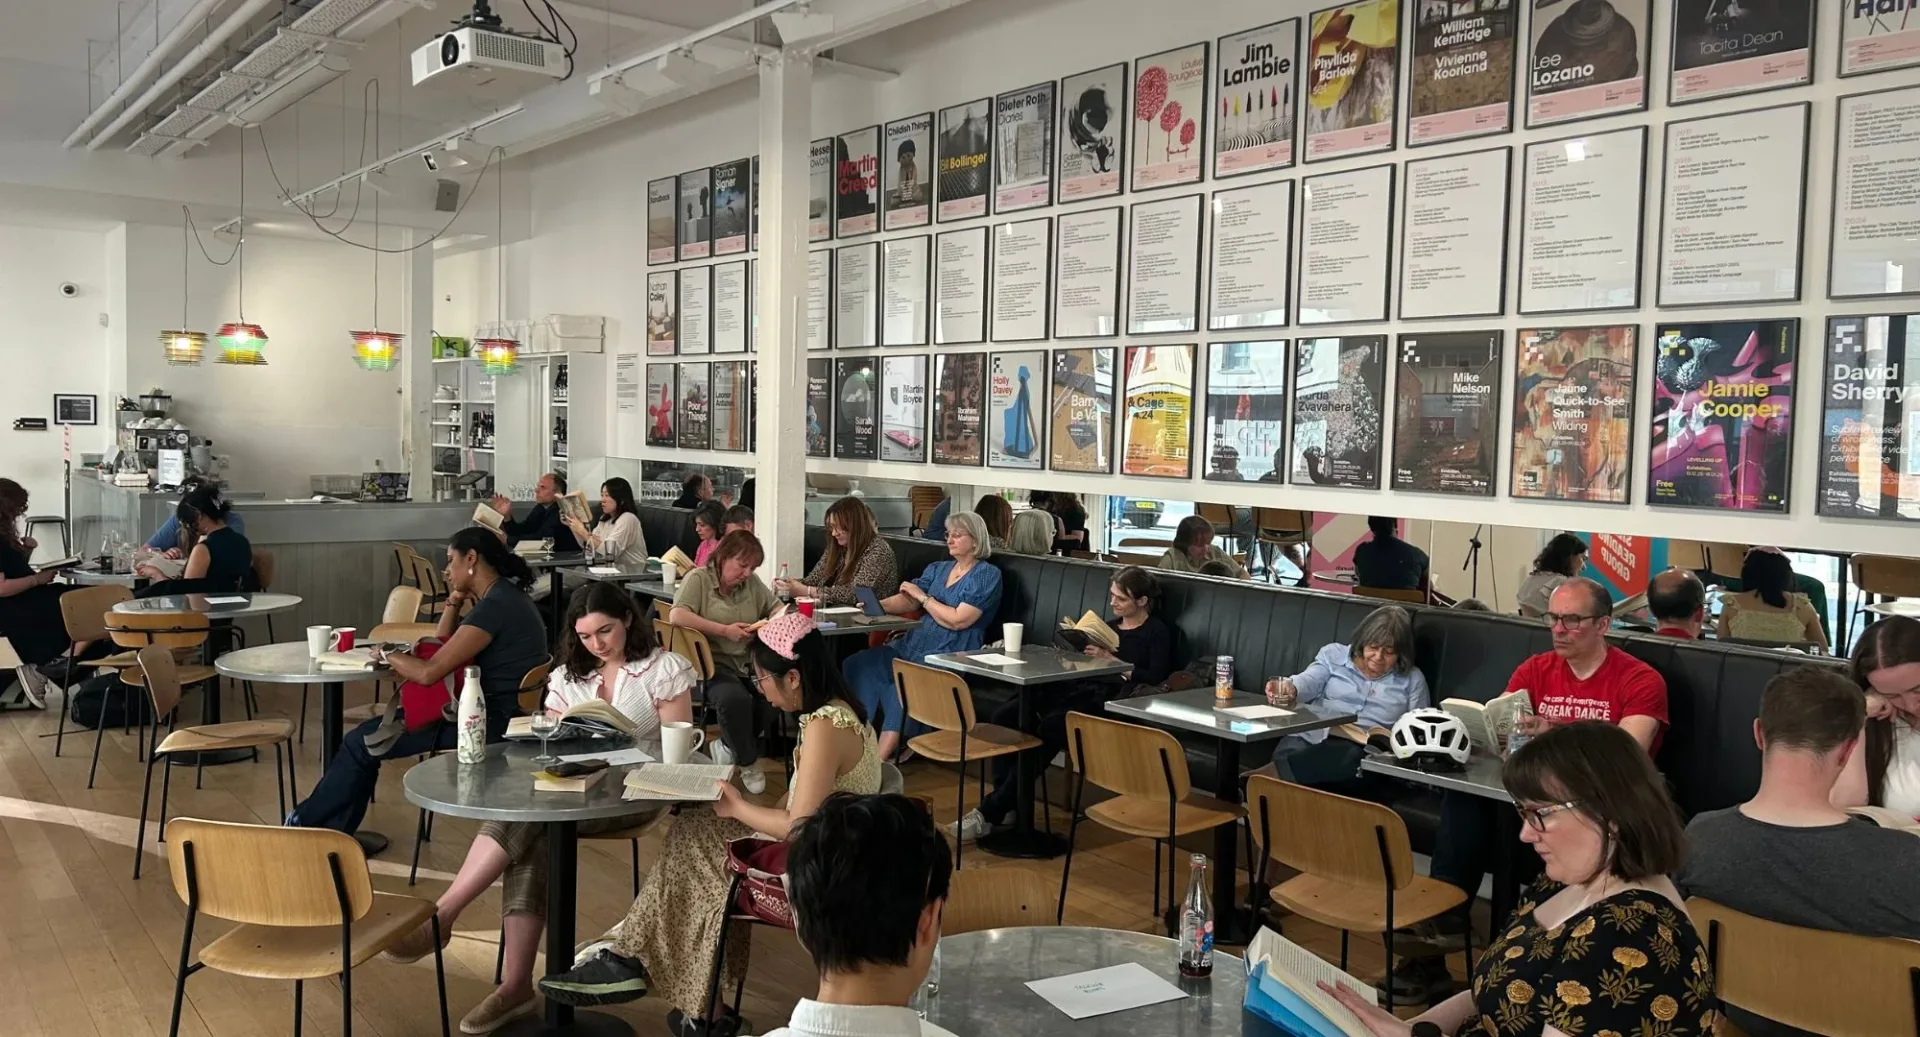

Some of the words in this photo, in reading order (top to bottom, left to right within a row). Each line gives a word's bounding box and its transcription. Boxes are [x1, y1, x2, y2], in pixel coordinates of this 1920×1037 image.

[1441, 17, 1484, 35] William
[1433, 26, 1491, 48] Kentridge
[1700, 38, 1739, 55] Tacita
[1743, 29, 1784, 47] Dean
[1240, 42, 1273, 65] Jim
[1436, 49, 1487, 69] Vivienne
[1313, 51, 1356, 71] Phyllida
[1534, 54, 1561, 70] Lee
[1223, 57, 1291, 87] Lambie
[1318, 65, 1357, 82] Barlow
[1433, 59, 1488, 81] Koorland
[1533, 64, 1595, 87] Lozano
[999, 99, 1024, 113] Dieter
[1025, 91, 1046, 106] Roth
[887, 125, 911, 137] Childish
[839, 154, 878, 177] Martin
[950, 152, 988, 171] Bollinger
[715, 177, 737, 191] Signer
[839, 173, 877, 195] Creed
[649, 292, 665, 303] Coley
[1453, 371, 1480, 383] Mike
[1834, 363, 1899, 381] David
[993, 376, 1010, 386] Holly
[902, 384, 924, 394] Martin
[992, 386, 1013, 395] Davey
[1452, 383, 1491, 394] Nelson
[1554, 383, 1587, 394] Jaune
[1700, 380, 1769, 397] Jamie
[1832, 383, 1908, 404] Sherry
[688, 401, 701, 410] Poor
[902, 394, 923, 404] Boyce
[1071, 395, 1099, 409] Barry
[1128, 397, 1135, 408] &
[1137, 397, 1164, 409] Cage
[1553, 395, 1625, 406] Quick-to-See
[1070, 408, 1083, 420] Le
[1085, 408, 1097, 420] Va
[1298, 402, 1352, 412] Zvavahera
[1552, 408, 1585, 419] Smith
[1700, 399, 1781, 419] Cooper
[688, 411, 707, 422] Things
[855, 416, 873, 426] Sarah
[855, 426, 873, 435] Wood
[1552, 420, 1588, 433] Wilding
[1656, 480, 1674, 488] Free
[1538, 702, 1573, 718] BREAK
[1574, 706, 1611, 721] DANCE
